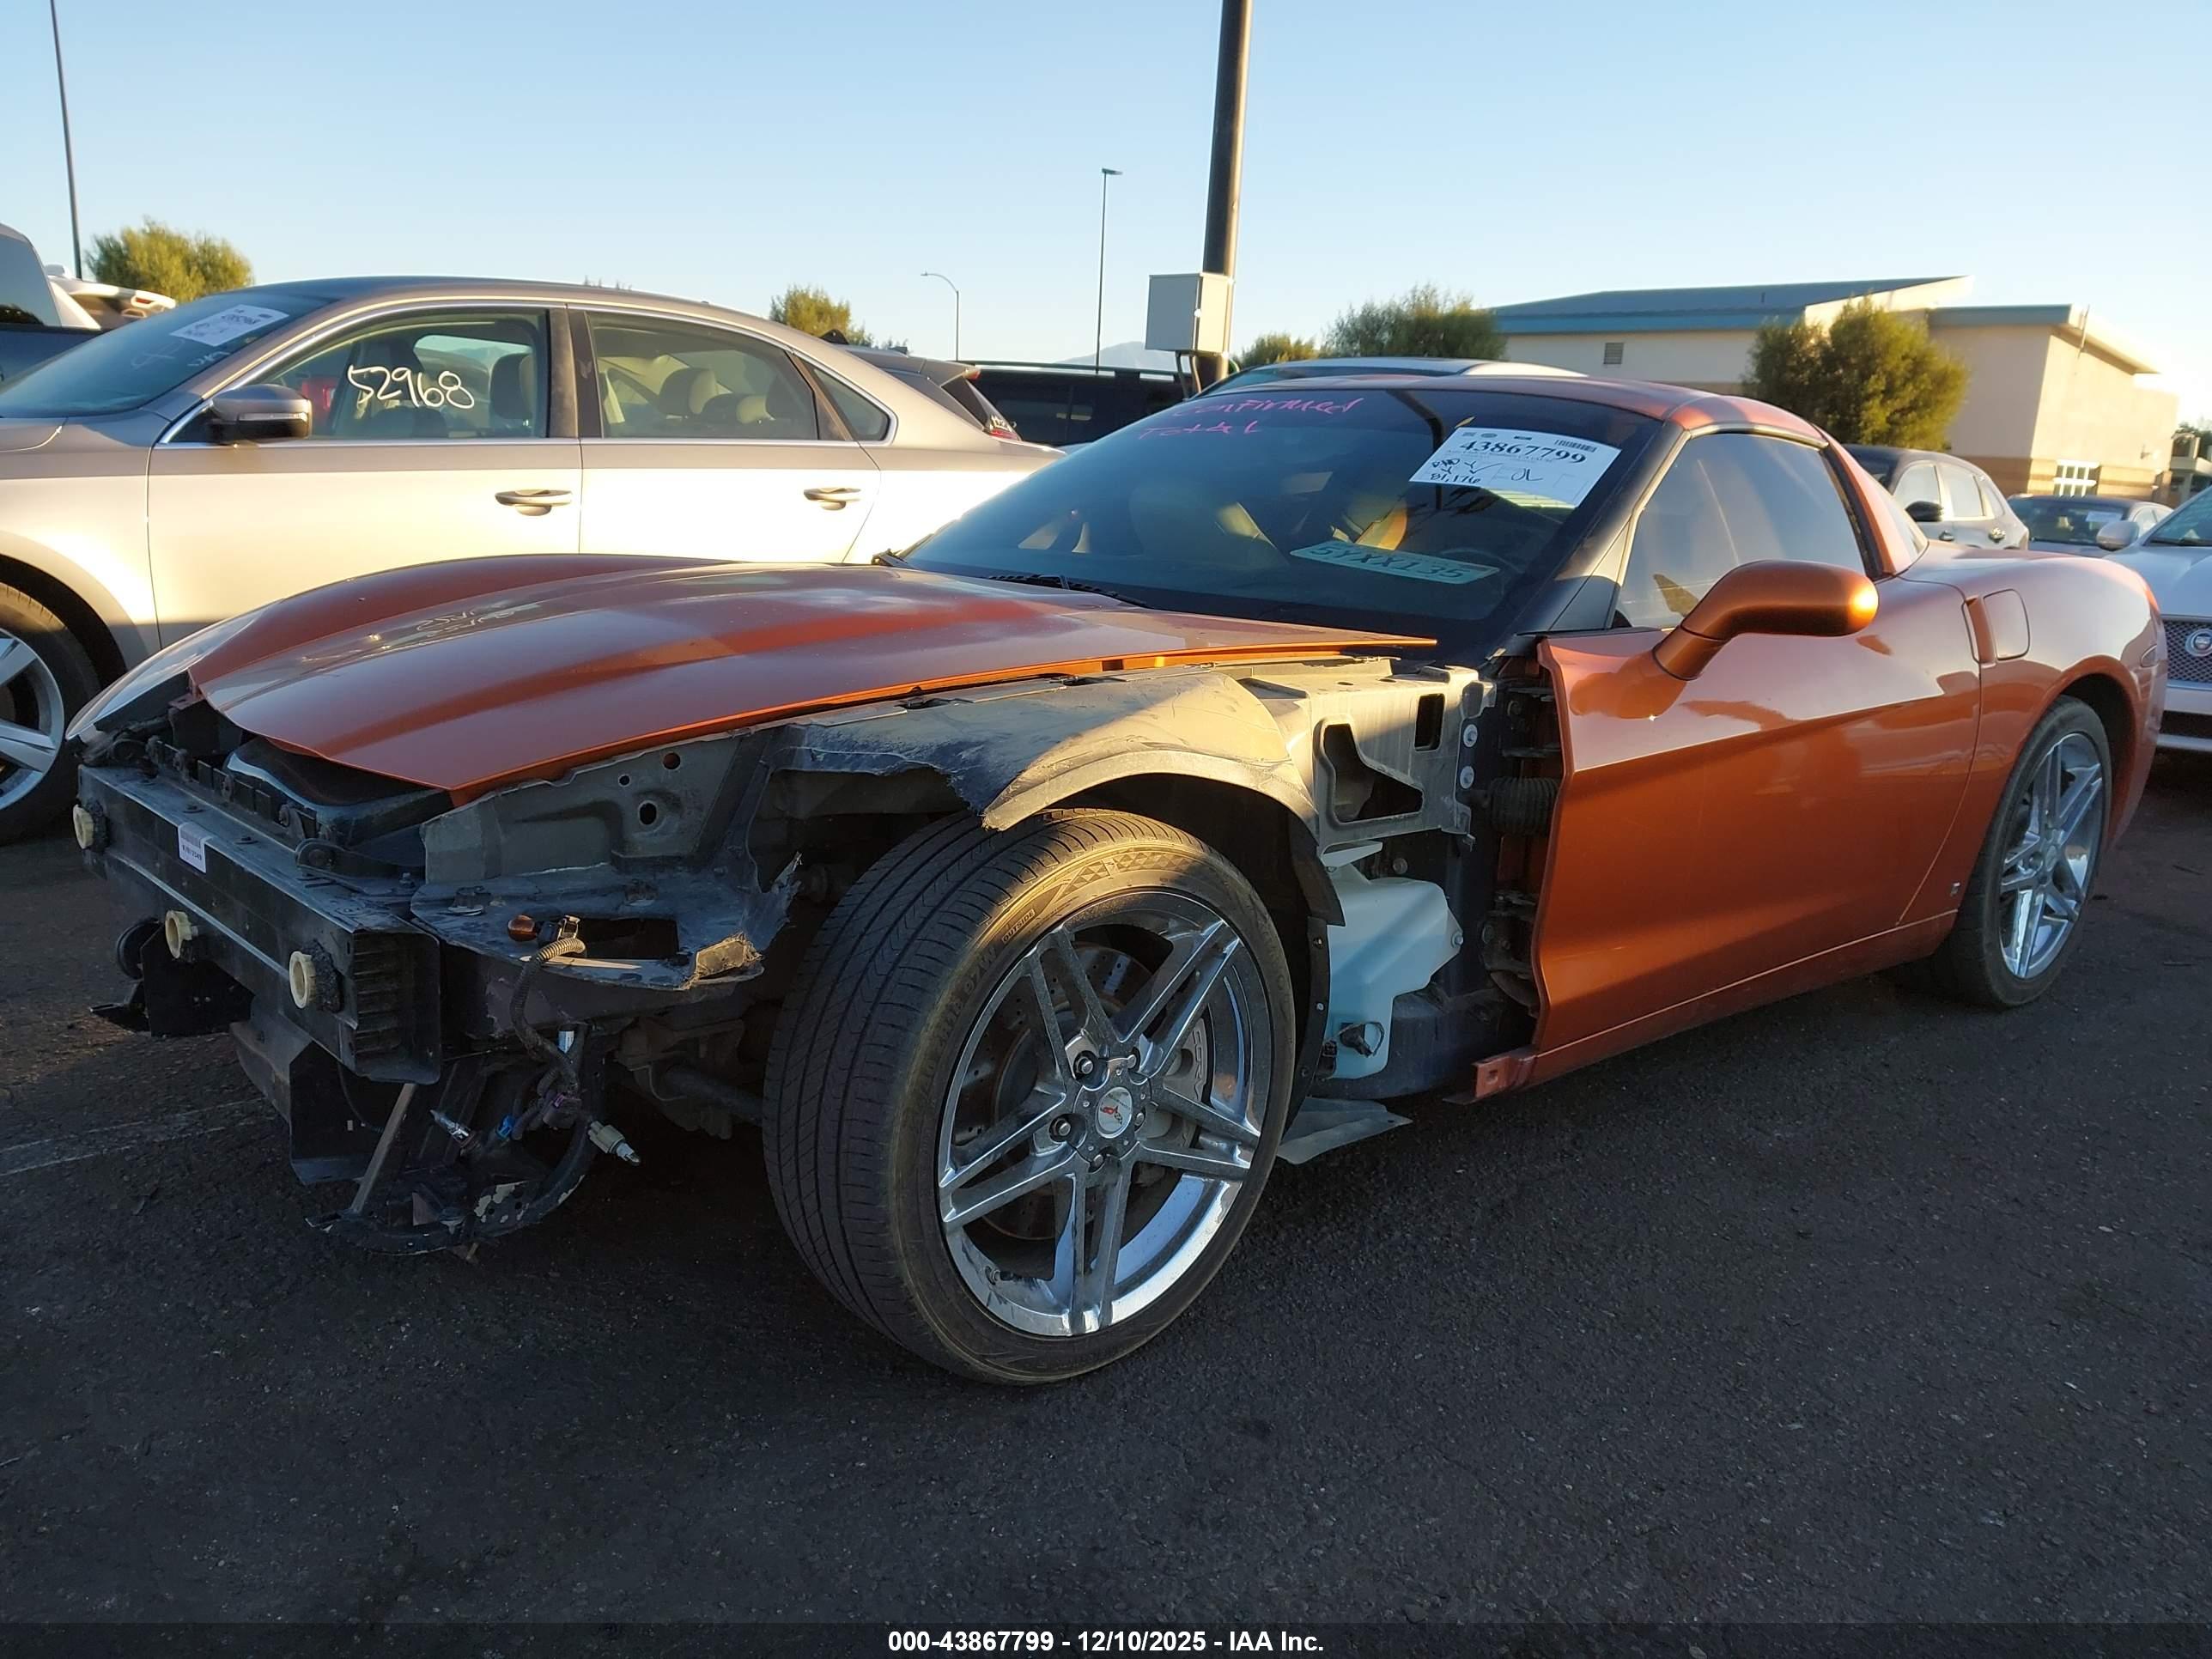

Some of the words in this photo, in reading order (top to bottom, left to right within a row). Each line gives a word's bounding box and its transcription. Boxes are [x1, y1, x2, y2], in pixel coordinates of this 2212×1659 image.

[348, 365, 474, 408] 52968
[1459, 440, 1587, 465] 43867799
[1310, 546, 1471, 579] 5YXX135
[1001, 908, 1036, 943] OUTSIDE
